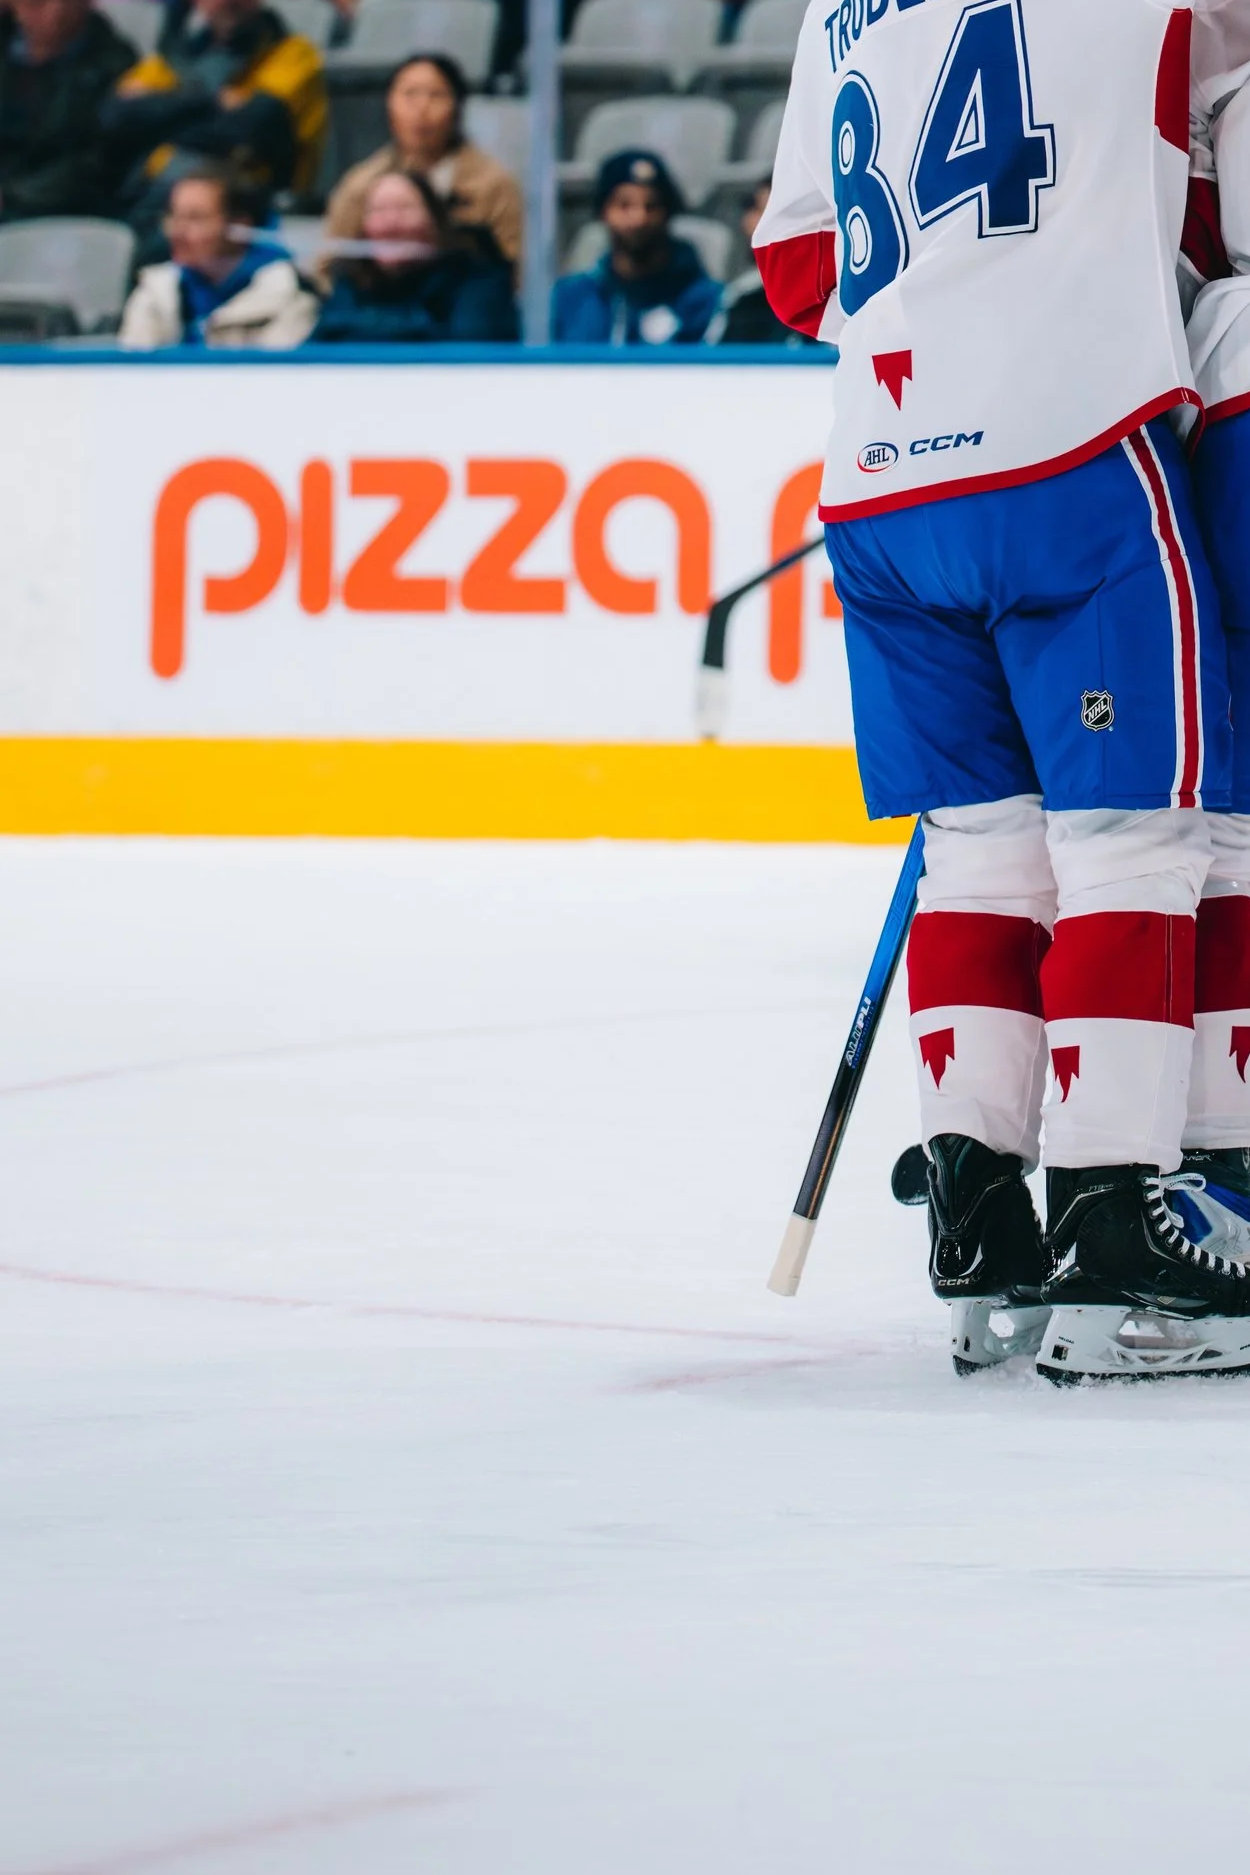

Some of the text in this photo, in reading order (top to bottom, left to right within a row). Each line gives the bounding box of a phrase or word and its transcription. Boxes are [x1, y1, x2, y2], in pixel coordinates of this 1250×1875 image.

[908, 430, 985, 456] CCM
[863, 446, 890, 467] AHL
[150, 456, 712, 680] pizza
[1088, 700, 1107, 722] NHL
[937, 1278, 971, 1287] CCM
